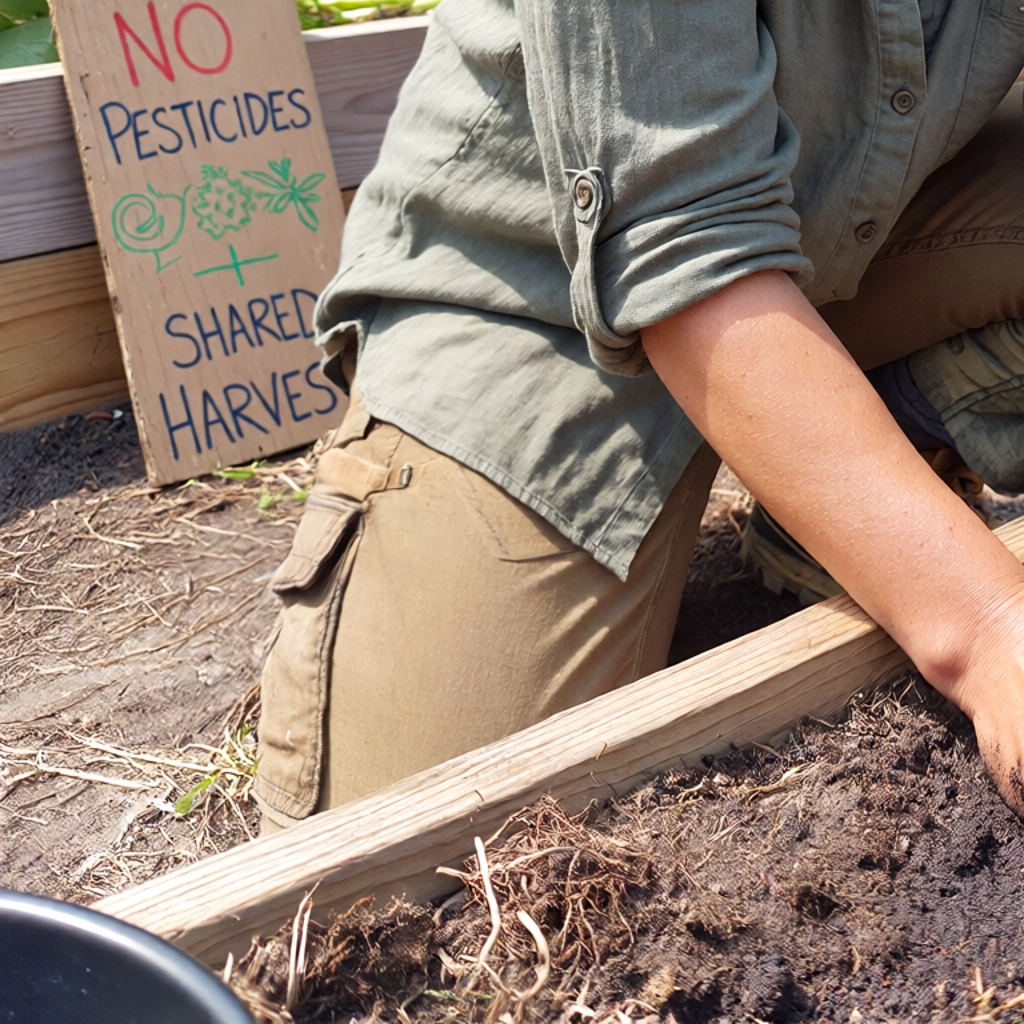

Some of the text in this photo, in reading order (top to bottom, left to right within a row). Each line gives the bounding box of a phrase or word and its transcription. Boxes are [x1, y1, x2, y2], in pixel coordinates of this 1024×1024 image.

[113, 1, 233, 87] NO
[100, 88, 312, 165] PESTICIDES
[165, 288, 319, 369] SHARED
[159, 361, 338, 460] HARVES
